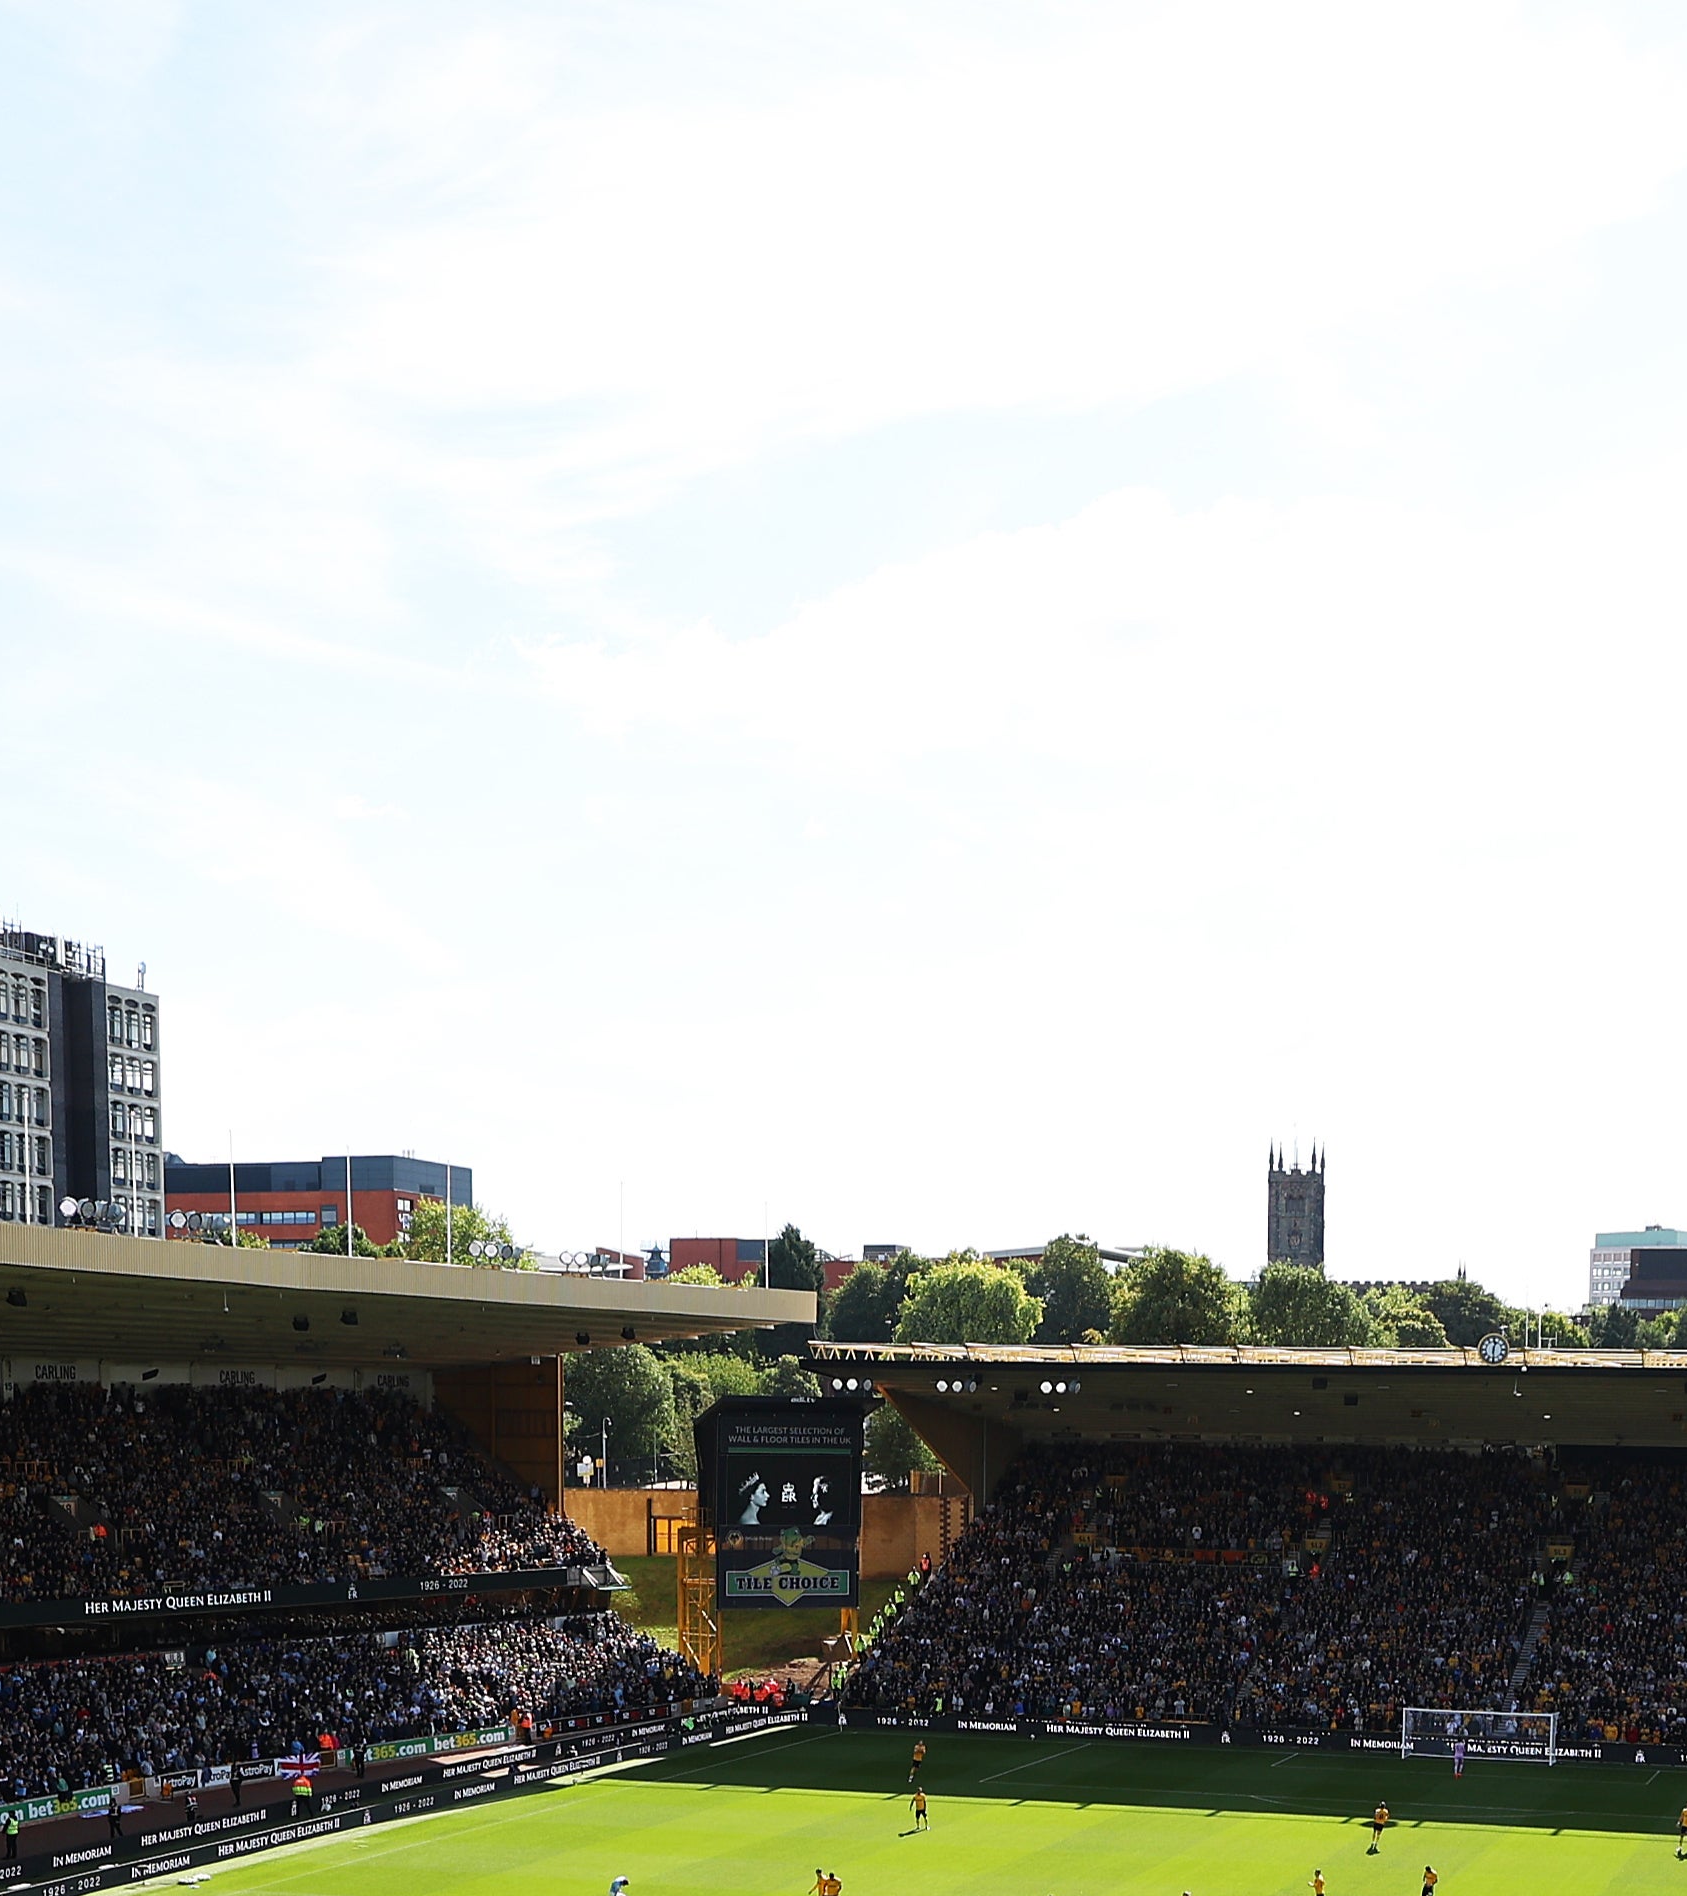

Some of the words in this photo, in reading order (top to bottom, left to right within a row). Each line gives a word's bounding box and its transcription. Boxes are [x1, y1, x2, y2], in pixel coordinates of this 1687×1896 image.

[34, 1364, 77, 1381] CARLING
[219, 1370, 255, 1384] CARLING
[735, 1426, 751, 1434] THE
[753, 1426, 788, 1435] LARGEST
[789, 1427, 832, 1435] SELECTION
[835, 1427, 845, 1436] OF
[728, 1435, 751, 1443] WALL
[761, 1435, 788, 1443] FLOOR
[790, 1436, 811, 1444] TILES
[820, 1436, 838, 1445] THE
[839, 1437, 852, 1445] UK
[420, 1580, 440, 1591] 1926
[448, 1578, 468, 1590] 2022
[736, 1577, 772, 1590] TILE
[779, 1577, 839, 1590] CHOICE
[84, 1600, 109, 1616] HER
[112, 1597, 163, 1614] MAJESTY
[166, 1594, 205, 1611] QUEEN
[207, 1591, 261, 1608] ELIZABETH
[768, 1713, 800, 1724] ELIZABETH
[957, 1720, 967, 1730] IN
[969, 1720, 1017, 1732] MEMORIAM
[1046, 1723, 1064, 1734] HER
[1065, 1724, 1103, 1736] MAJESTY
[1105, 1725, 1136, 1738] QUEEN
[1137, 1728, 1182, 1740] ELIZABETH
[433, 1730, 505, 1752] bet365.com
[1296, 1735, 1320, 1746] 2022
[1509, 1745, 1543, 1758] QUEEN
[442, 1766, 454, 1778] HER
[455, 1760, 481, 1775] MAJESTY
[482, 1756, 502, 1770] QUEEN
[503, 1750, 530, 1765] ELIZABETH
[389, 1775, 423, 1791] MEMORIAM
[513, 1774, 526, 1785] HER
[526, 1767, 550, 1783] MAJESTY
[463, 1781, 495, 1798] MEMORIAM
[141, 1833, 157, 1847] HER
[159, 1825, 193, 1843] MAJESTY
[194, 1820, 221, 1837] QUEEN
[222, 1810, 259, 1828] ELIZABETH
[218, 1844, 234, 1857] HER
[236, 1835, 269, 1854] MAJESTY
[270, 1829, 296, 1847] QUEEN
[297, 1820, 333, 1838] ELIZABETH
[53, 1854, 64, 1868] IN
[65, 1844, 112, 1866] MEMORIAM
[0, 1865, 23, 1880] 2022
[131, 1866, 142, 1879] IN
[78, 1876, 102, 1891] 2022
